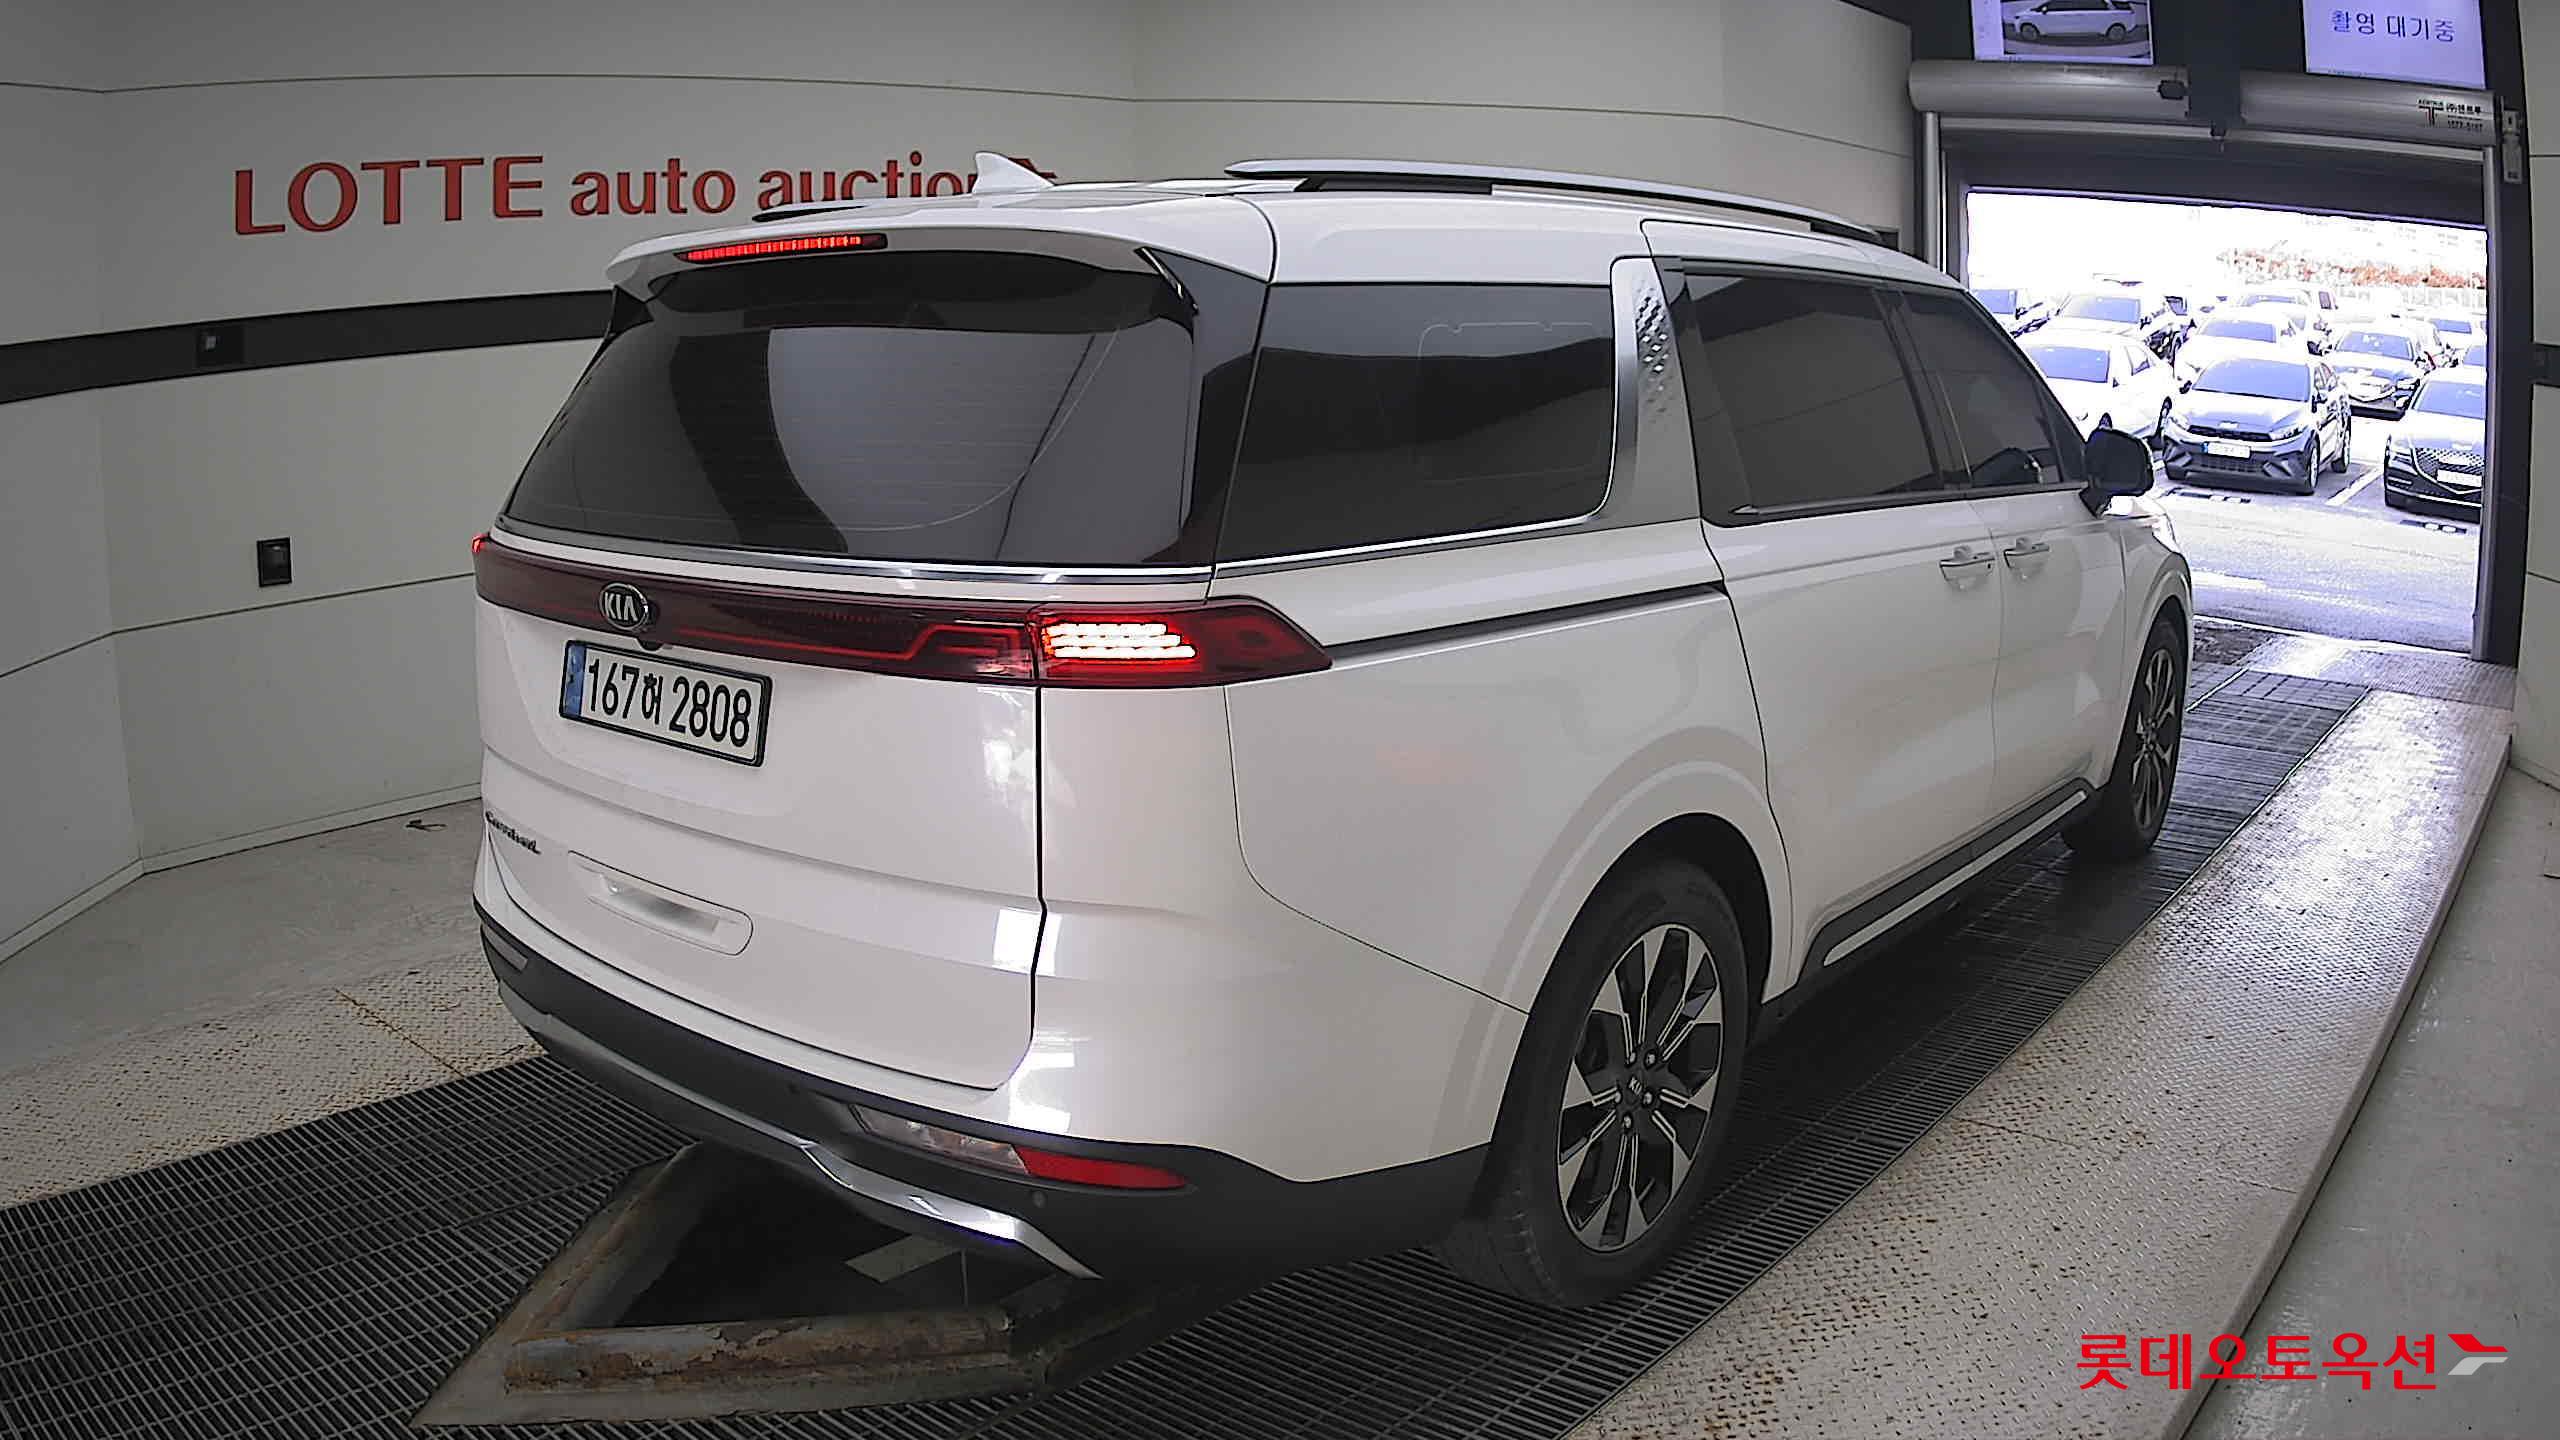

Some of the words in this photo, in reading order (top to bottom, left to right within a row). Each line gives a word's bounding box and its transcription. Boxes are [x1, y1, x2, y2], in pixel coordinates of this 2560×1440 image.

[2332, 10, 2375, 35] 촬영
[2386, 15, 2455, 42] 대기중
[235, 155, 544, 235] LOTTE
[570, 158, 737, 216] auto
[757, 151, 976, 210] auctio
[604, 592, 638, 621] KIA
[588, 658, 664, 725] 167허
[669, 675, 752, 748] 2808
